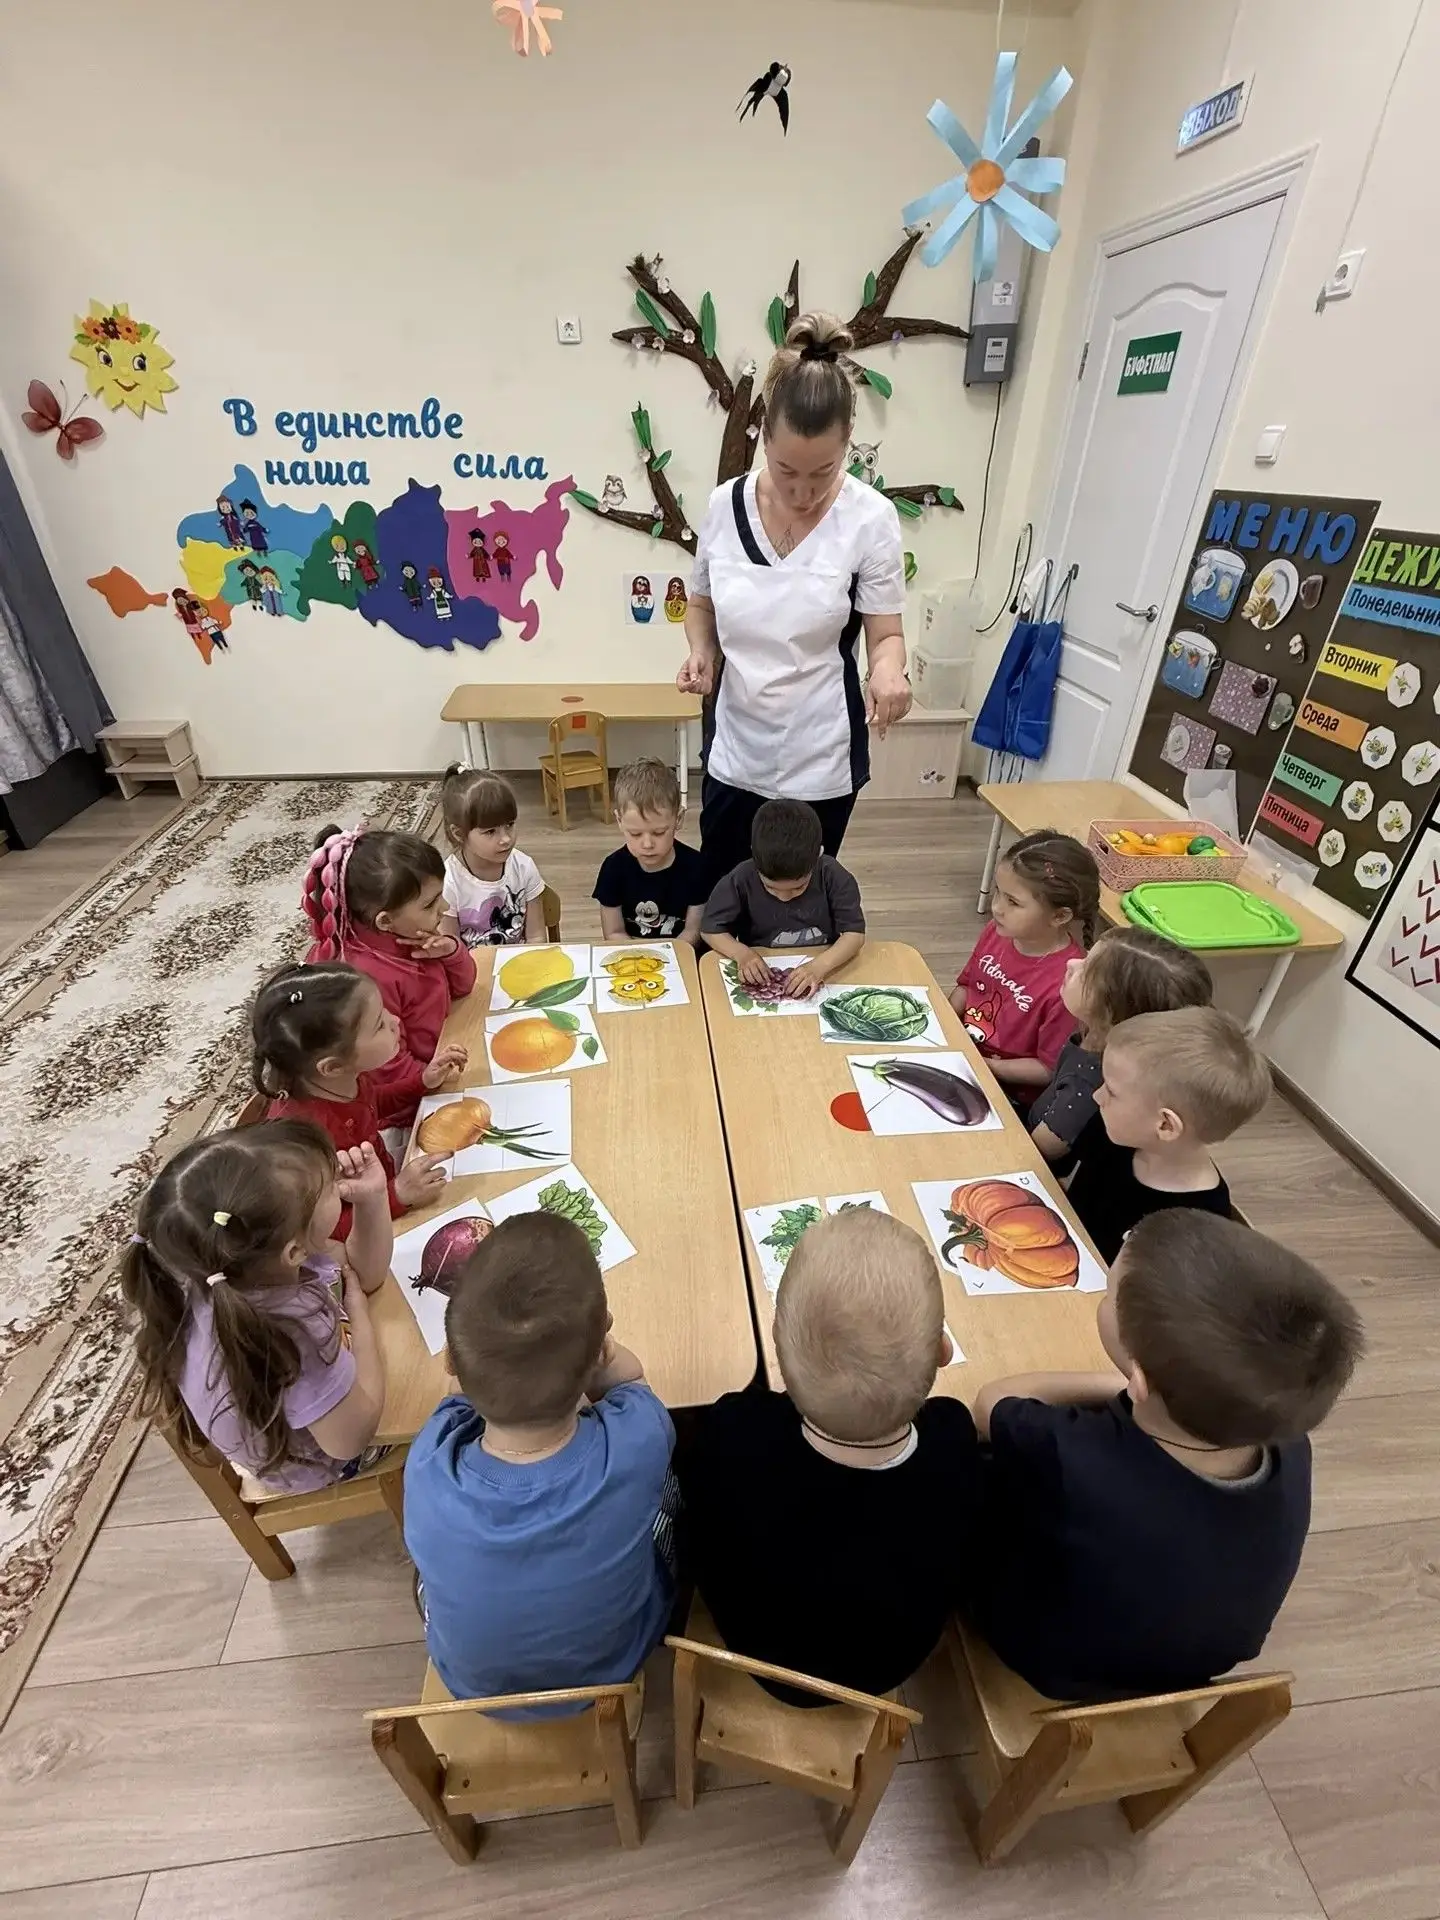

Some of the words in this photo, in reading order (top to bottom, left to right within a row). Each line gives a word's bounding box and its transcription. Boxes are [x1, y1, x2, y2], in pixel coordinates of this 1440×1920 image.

[1182, 89, 1240, 144] ВЫХОД
[1123, 350, 1175, 377] БУФЕТНАЯ
[223, 398, 257, 436] В
[275, 397, 464, 453] единстве
[264, 459, 370, 485] наша
[453, 453, 548, 480] сила
[1206, 500, 1356, 564] МЕНЮ
[1353, 540, 1440, 590] ДЕЖУ
[1324, 646, 1382, 678] Вторник
[1301, 703, 1340, 732] Среда
[1281, 755, 1327, 791] Четверг
[1264, 796, 1310, 834] Пятница
[979, 954, 1033, 1012] Adorable
